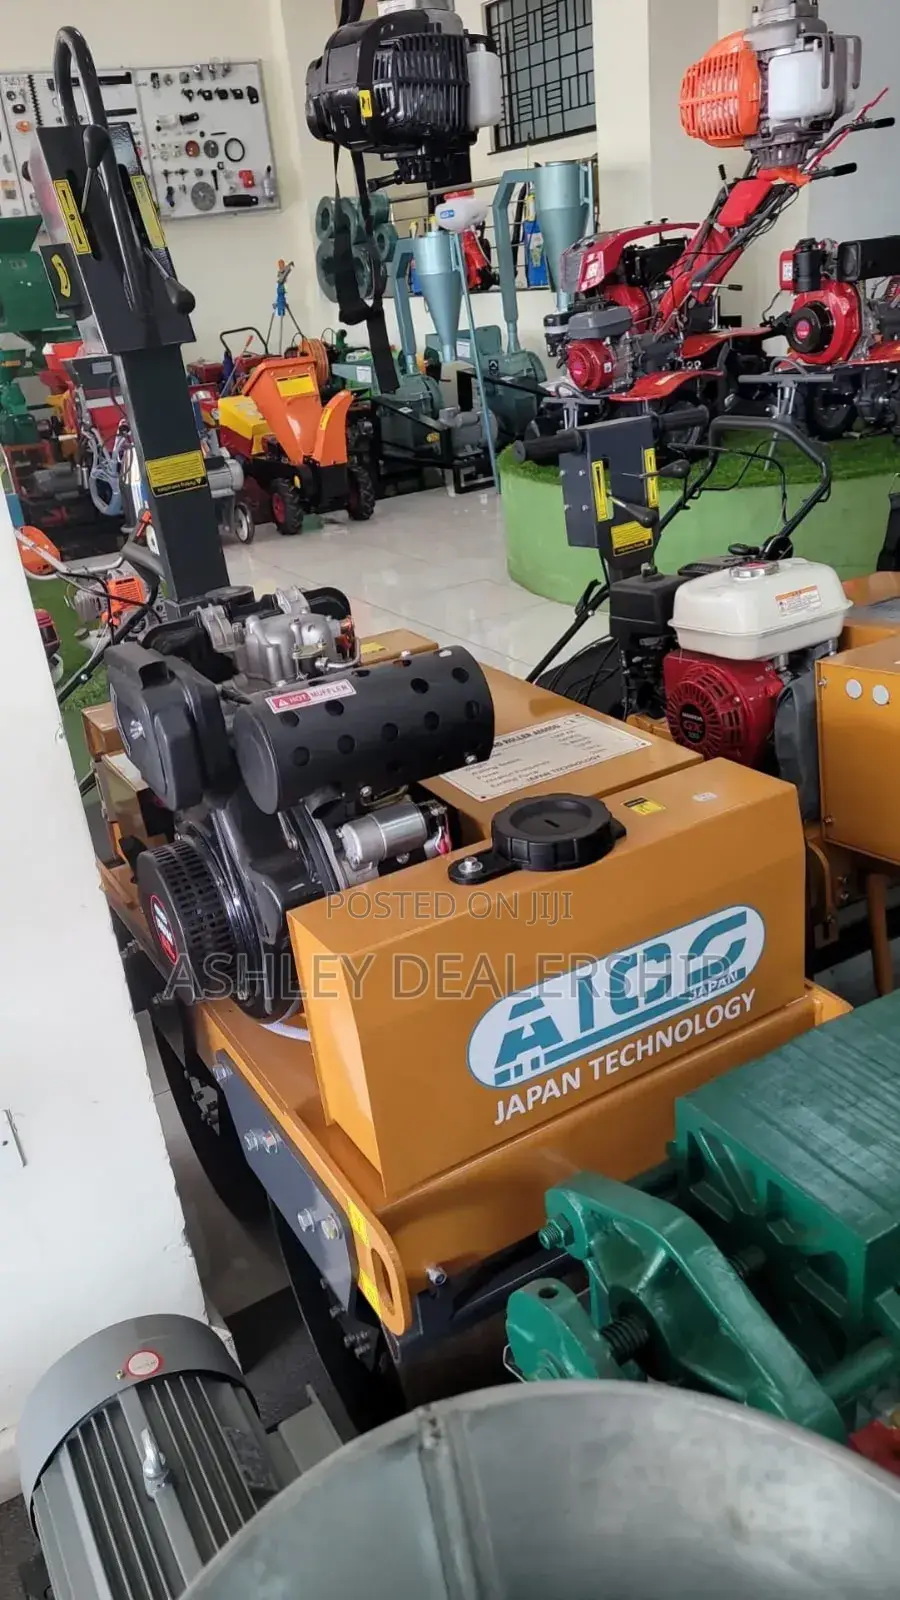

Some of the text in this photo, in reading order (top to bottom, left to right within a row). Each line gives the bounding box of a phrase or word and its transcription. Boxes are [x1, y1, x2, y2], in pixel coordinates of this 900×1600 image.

[288, 683, 348, 704] HOT MUFFLER
[692, 969, 738, 1000] JAPAN
[494, 988, 756, 1126] JAPAN TECHNOLOGY
